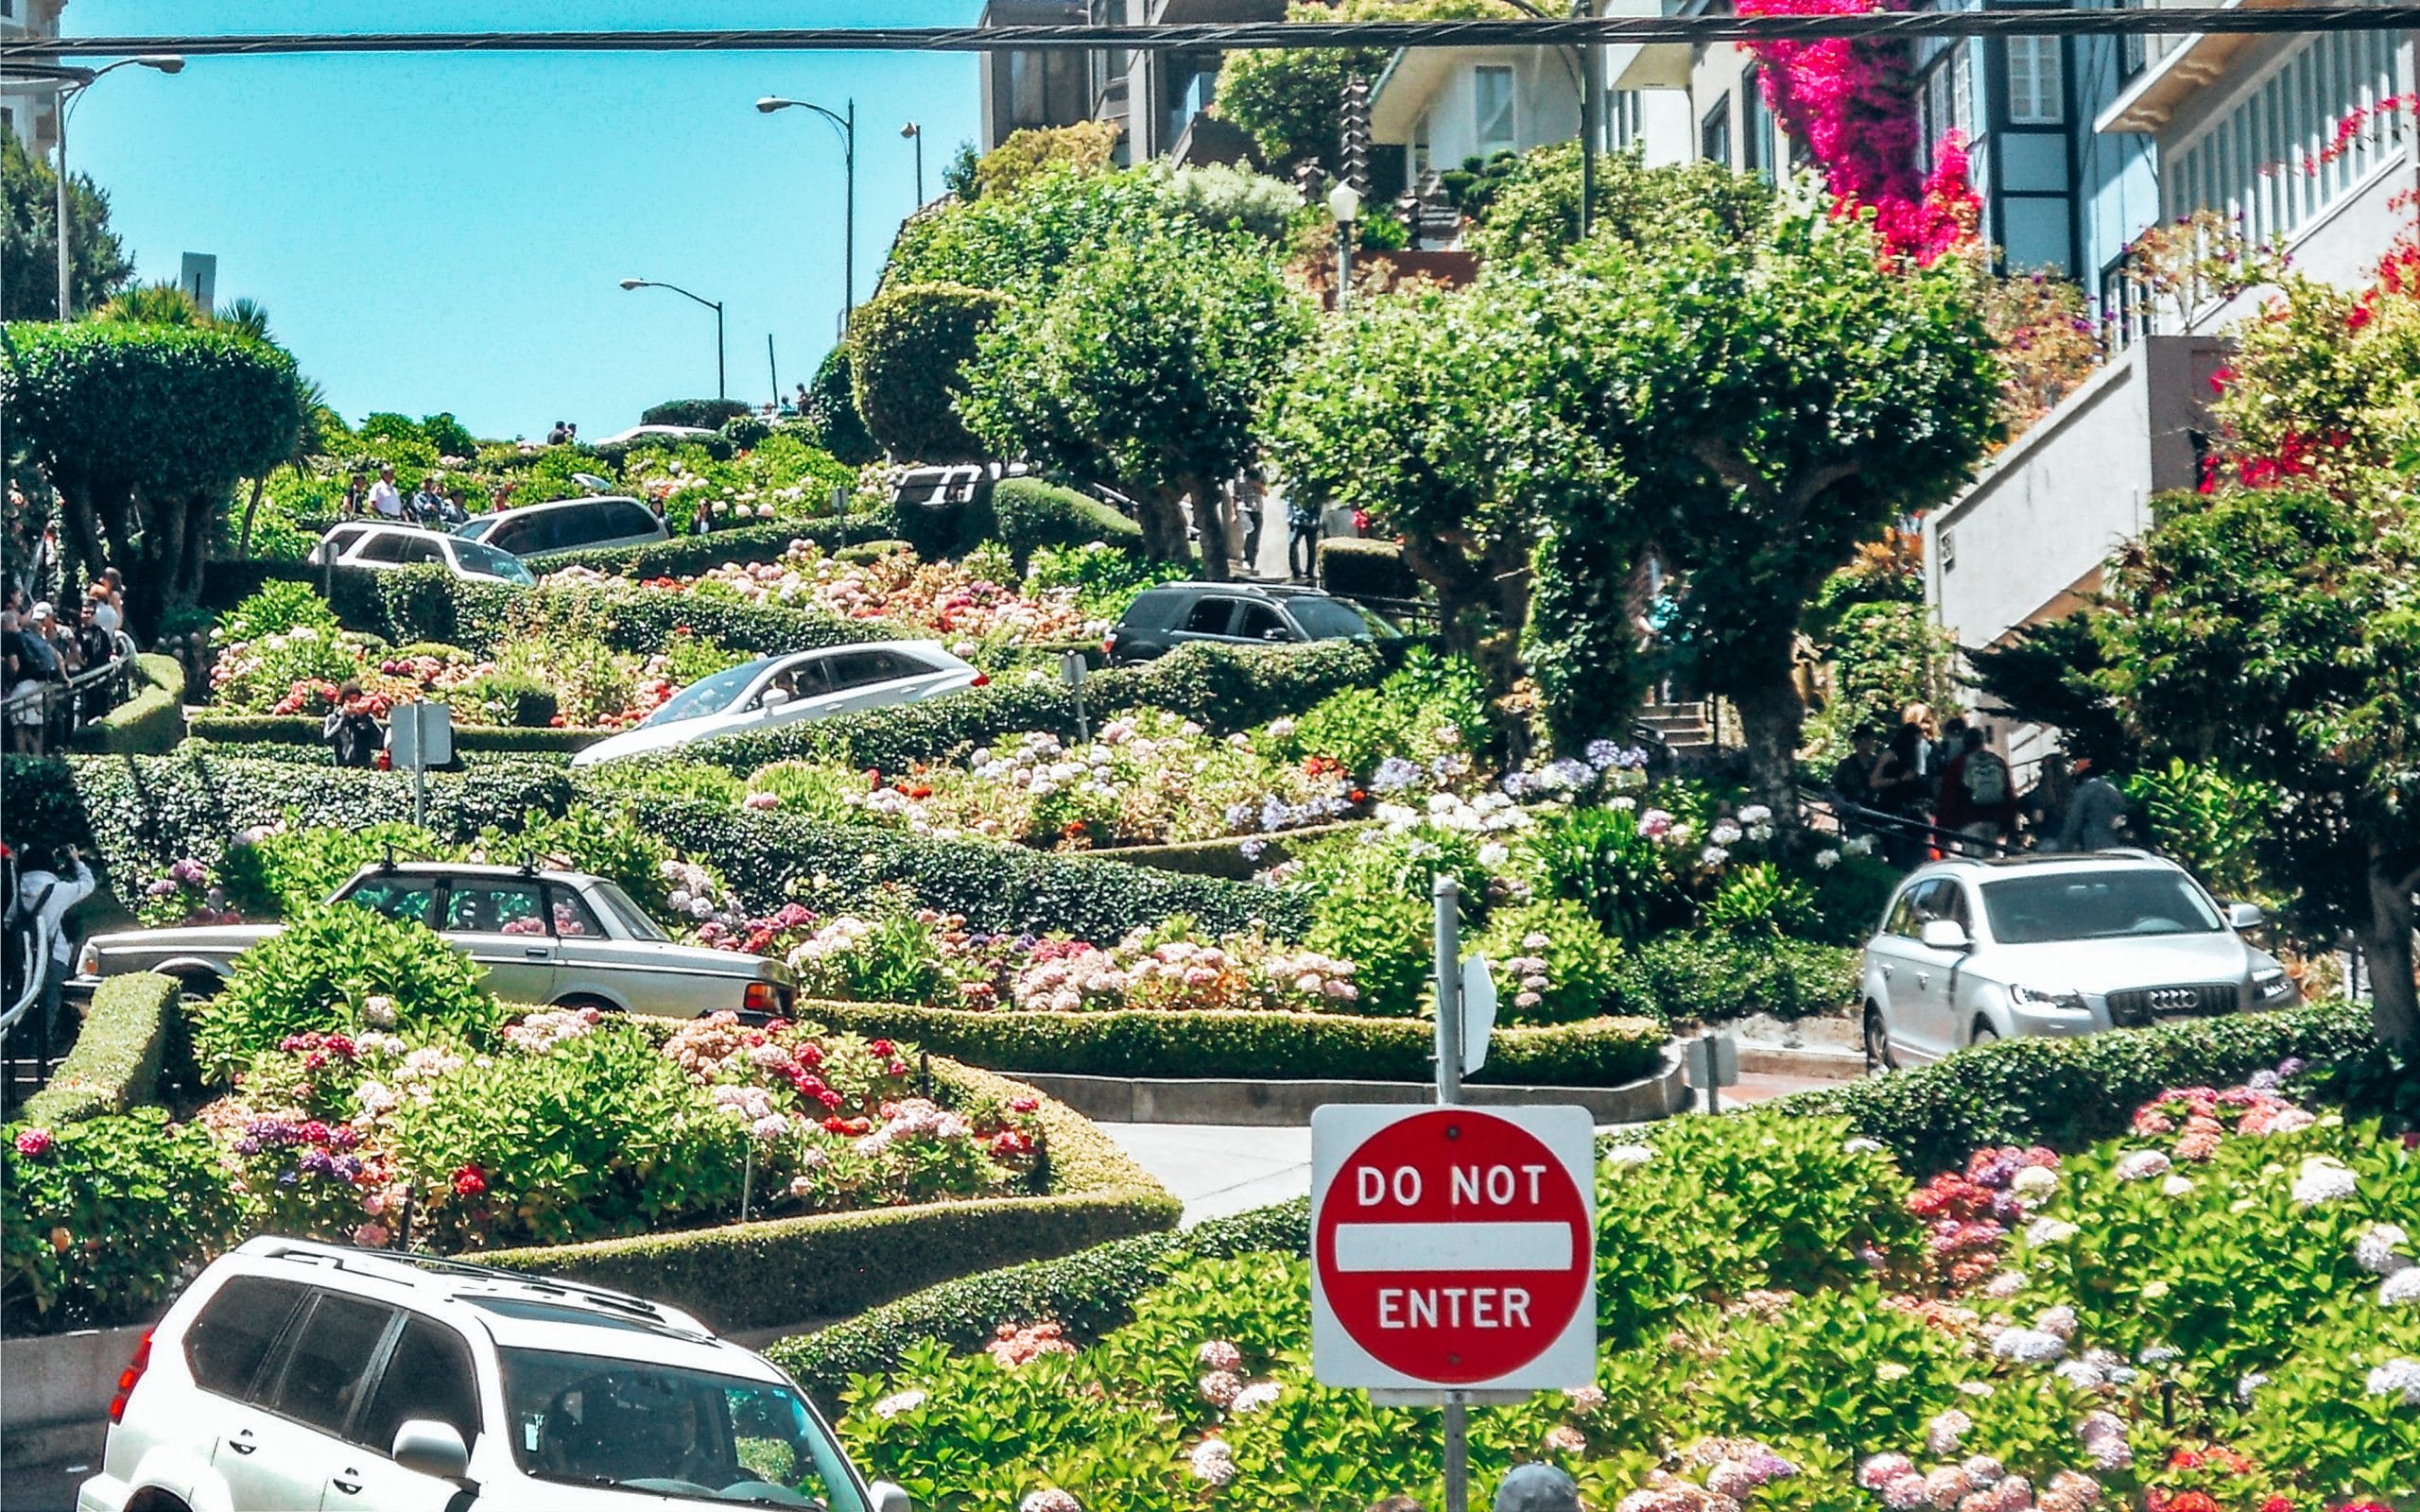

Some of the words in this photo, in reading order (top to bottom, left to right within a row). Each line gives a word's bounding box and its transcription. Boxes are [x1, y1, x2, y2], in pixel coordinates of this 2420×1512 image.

[1357, 1166, 1422, 1206] DO
[1451, 1164, 1547, 1206] NOT
[1378, 1288, 1530, 1329] ENTER
